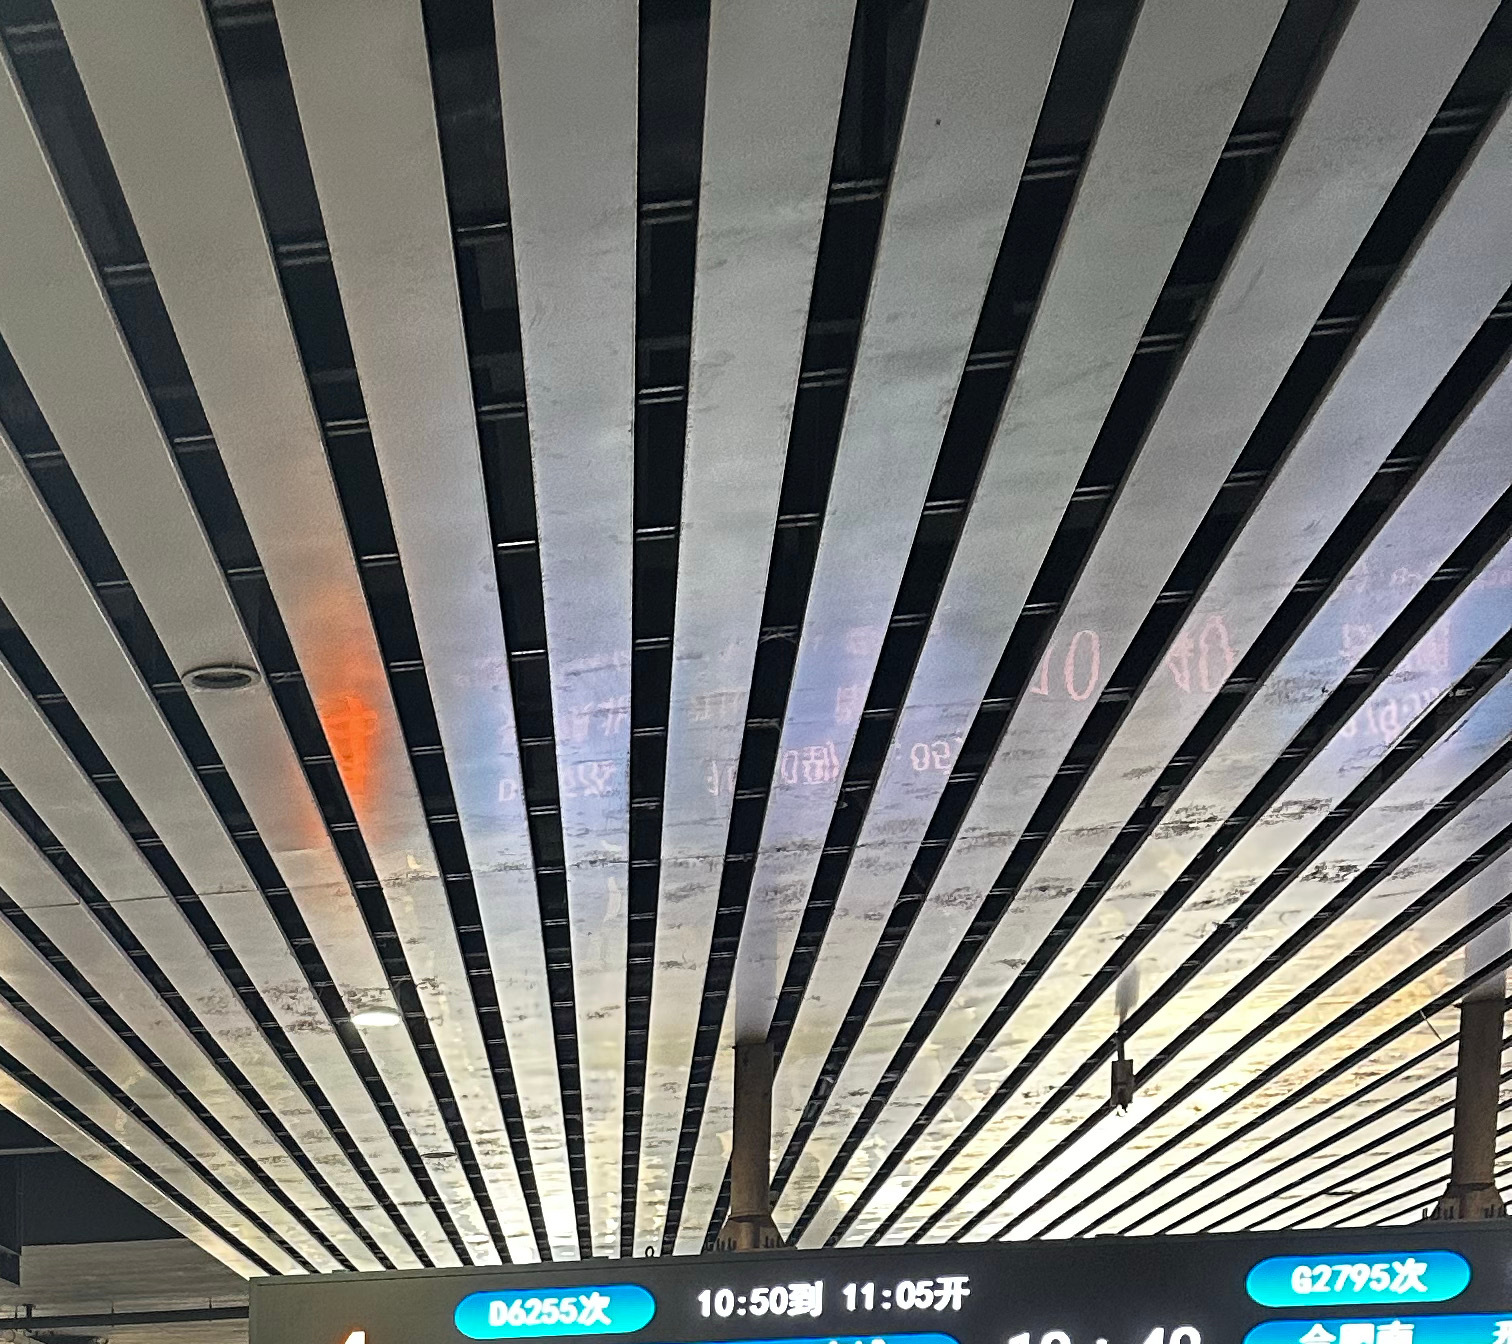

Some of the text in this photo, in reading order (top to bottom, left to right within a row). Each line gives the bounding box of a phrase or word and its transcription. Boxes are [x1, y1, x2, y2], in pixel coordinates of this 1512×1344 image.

[1291, 1258, 1428, 1294] G2795次
[489, 1276, 970, 1327] D6255次 10:50到 11:05开
